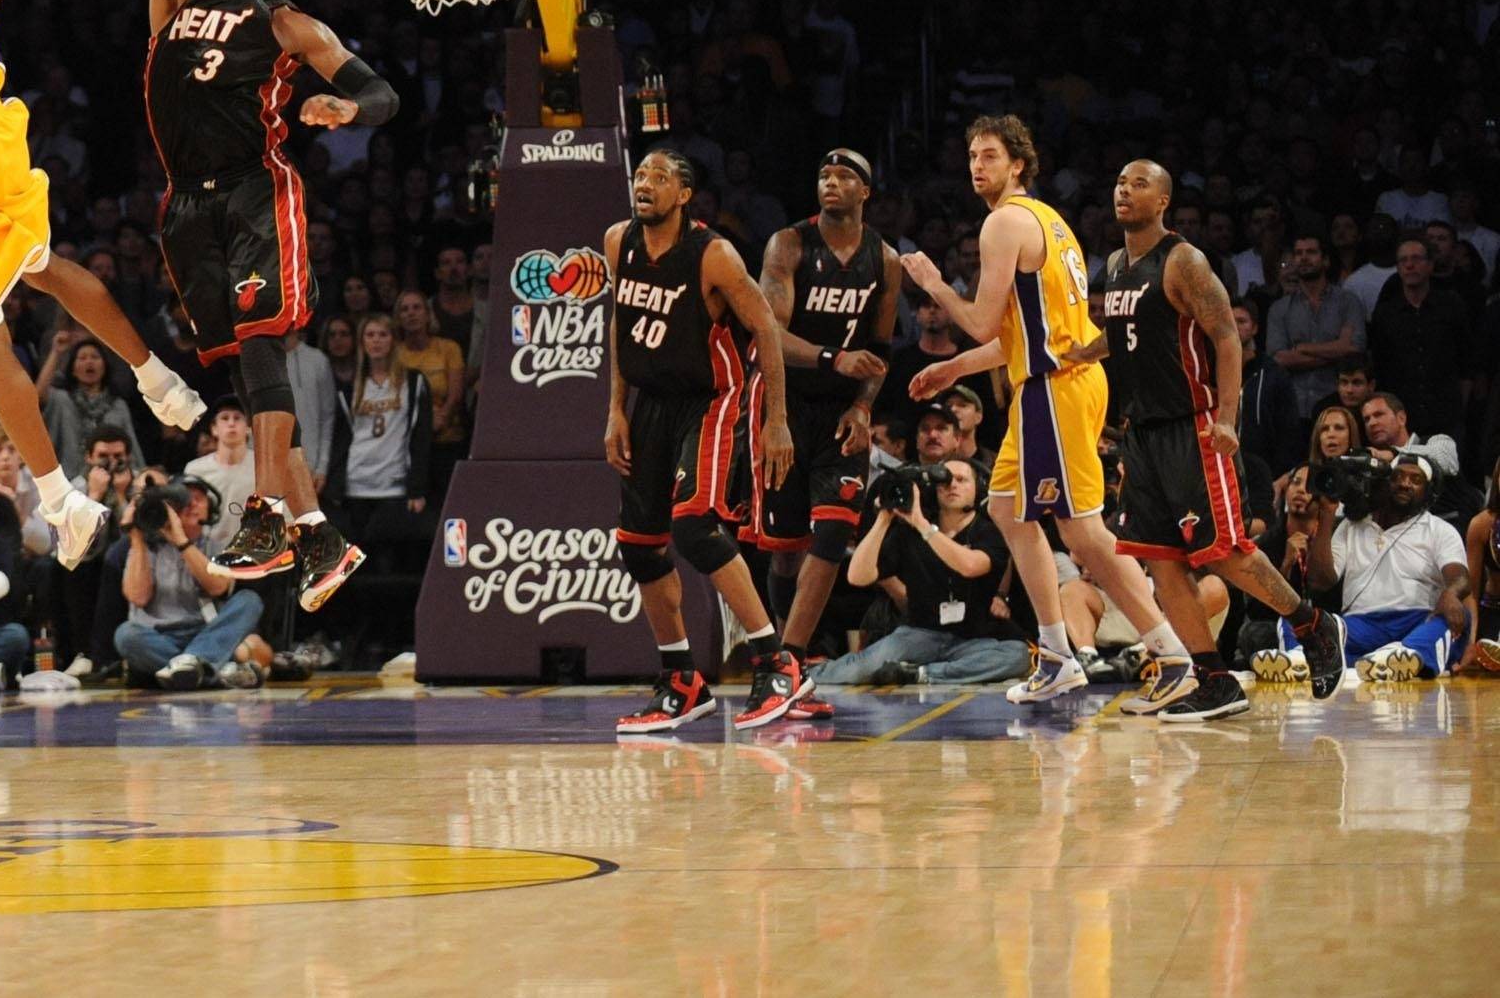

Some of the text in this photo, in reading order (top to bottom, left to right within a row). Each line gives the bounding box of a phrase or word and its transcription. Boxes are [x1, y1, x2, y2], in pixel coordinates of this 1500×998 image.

[167, 7, 254, 43] HEAT
[194, 48, 225, 82] 3
[521, 142, 605, 164] SPALDING
[616, 277, 687, 315] HEAT
[805, 281, 877, 314] HEAT
[1104, 282, 1150, 317] HEAT
[532, 304, 605, 345] NBA
[631, 315, 668, 350] 40
[842, 318, 858, 348] 7
[1126, 323, 1138, 352] 5
[510, 344, 604, 384] Cares
[465, 561, 643, 623] of Giving
